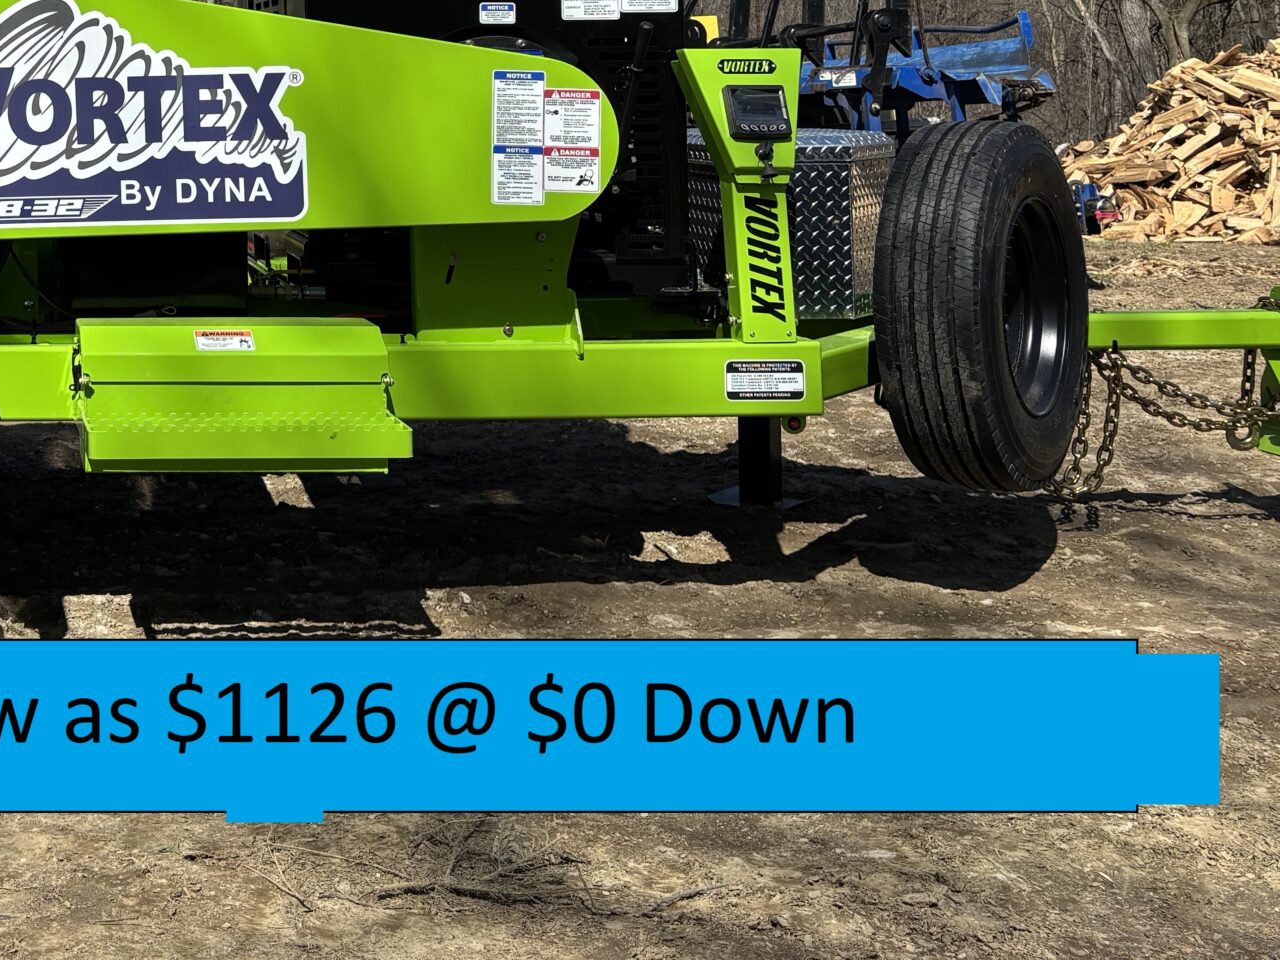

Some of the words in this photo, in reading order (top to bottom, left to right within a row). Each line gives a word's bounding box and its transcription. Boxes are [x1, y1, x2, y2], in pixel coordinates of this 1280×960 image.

[724, 61, 769, 73] VORTEX
[120, 180, 161, 211] By
[176, 177, 272, 204] DYNA
[744, 194, 786, 324] VORTEX
